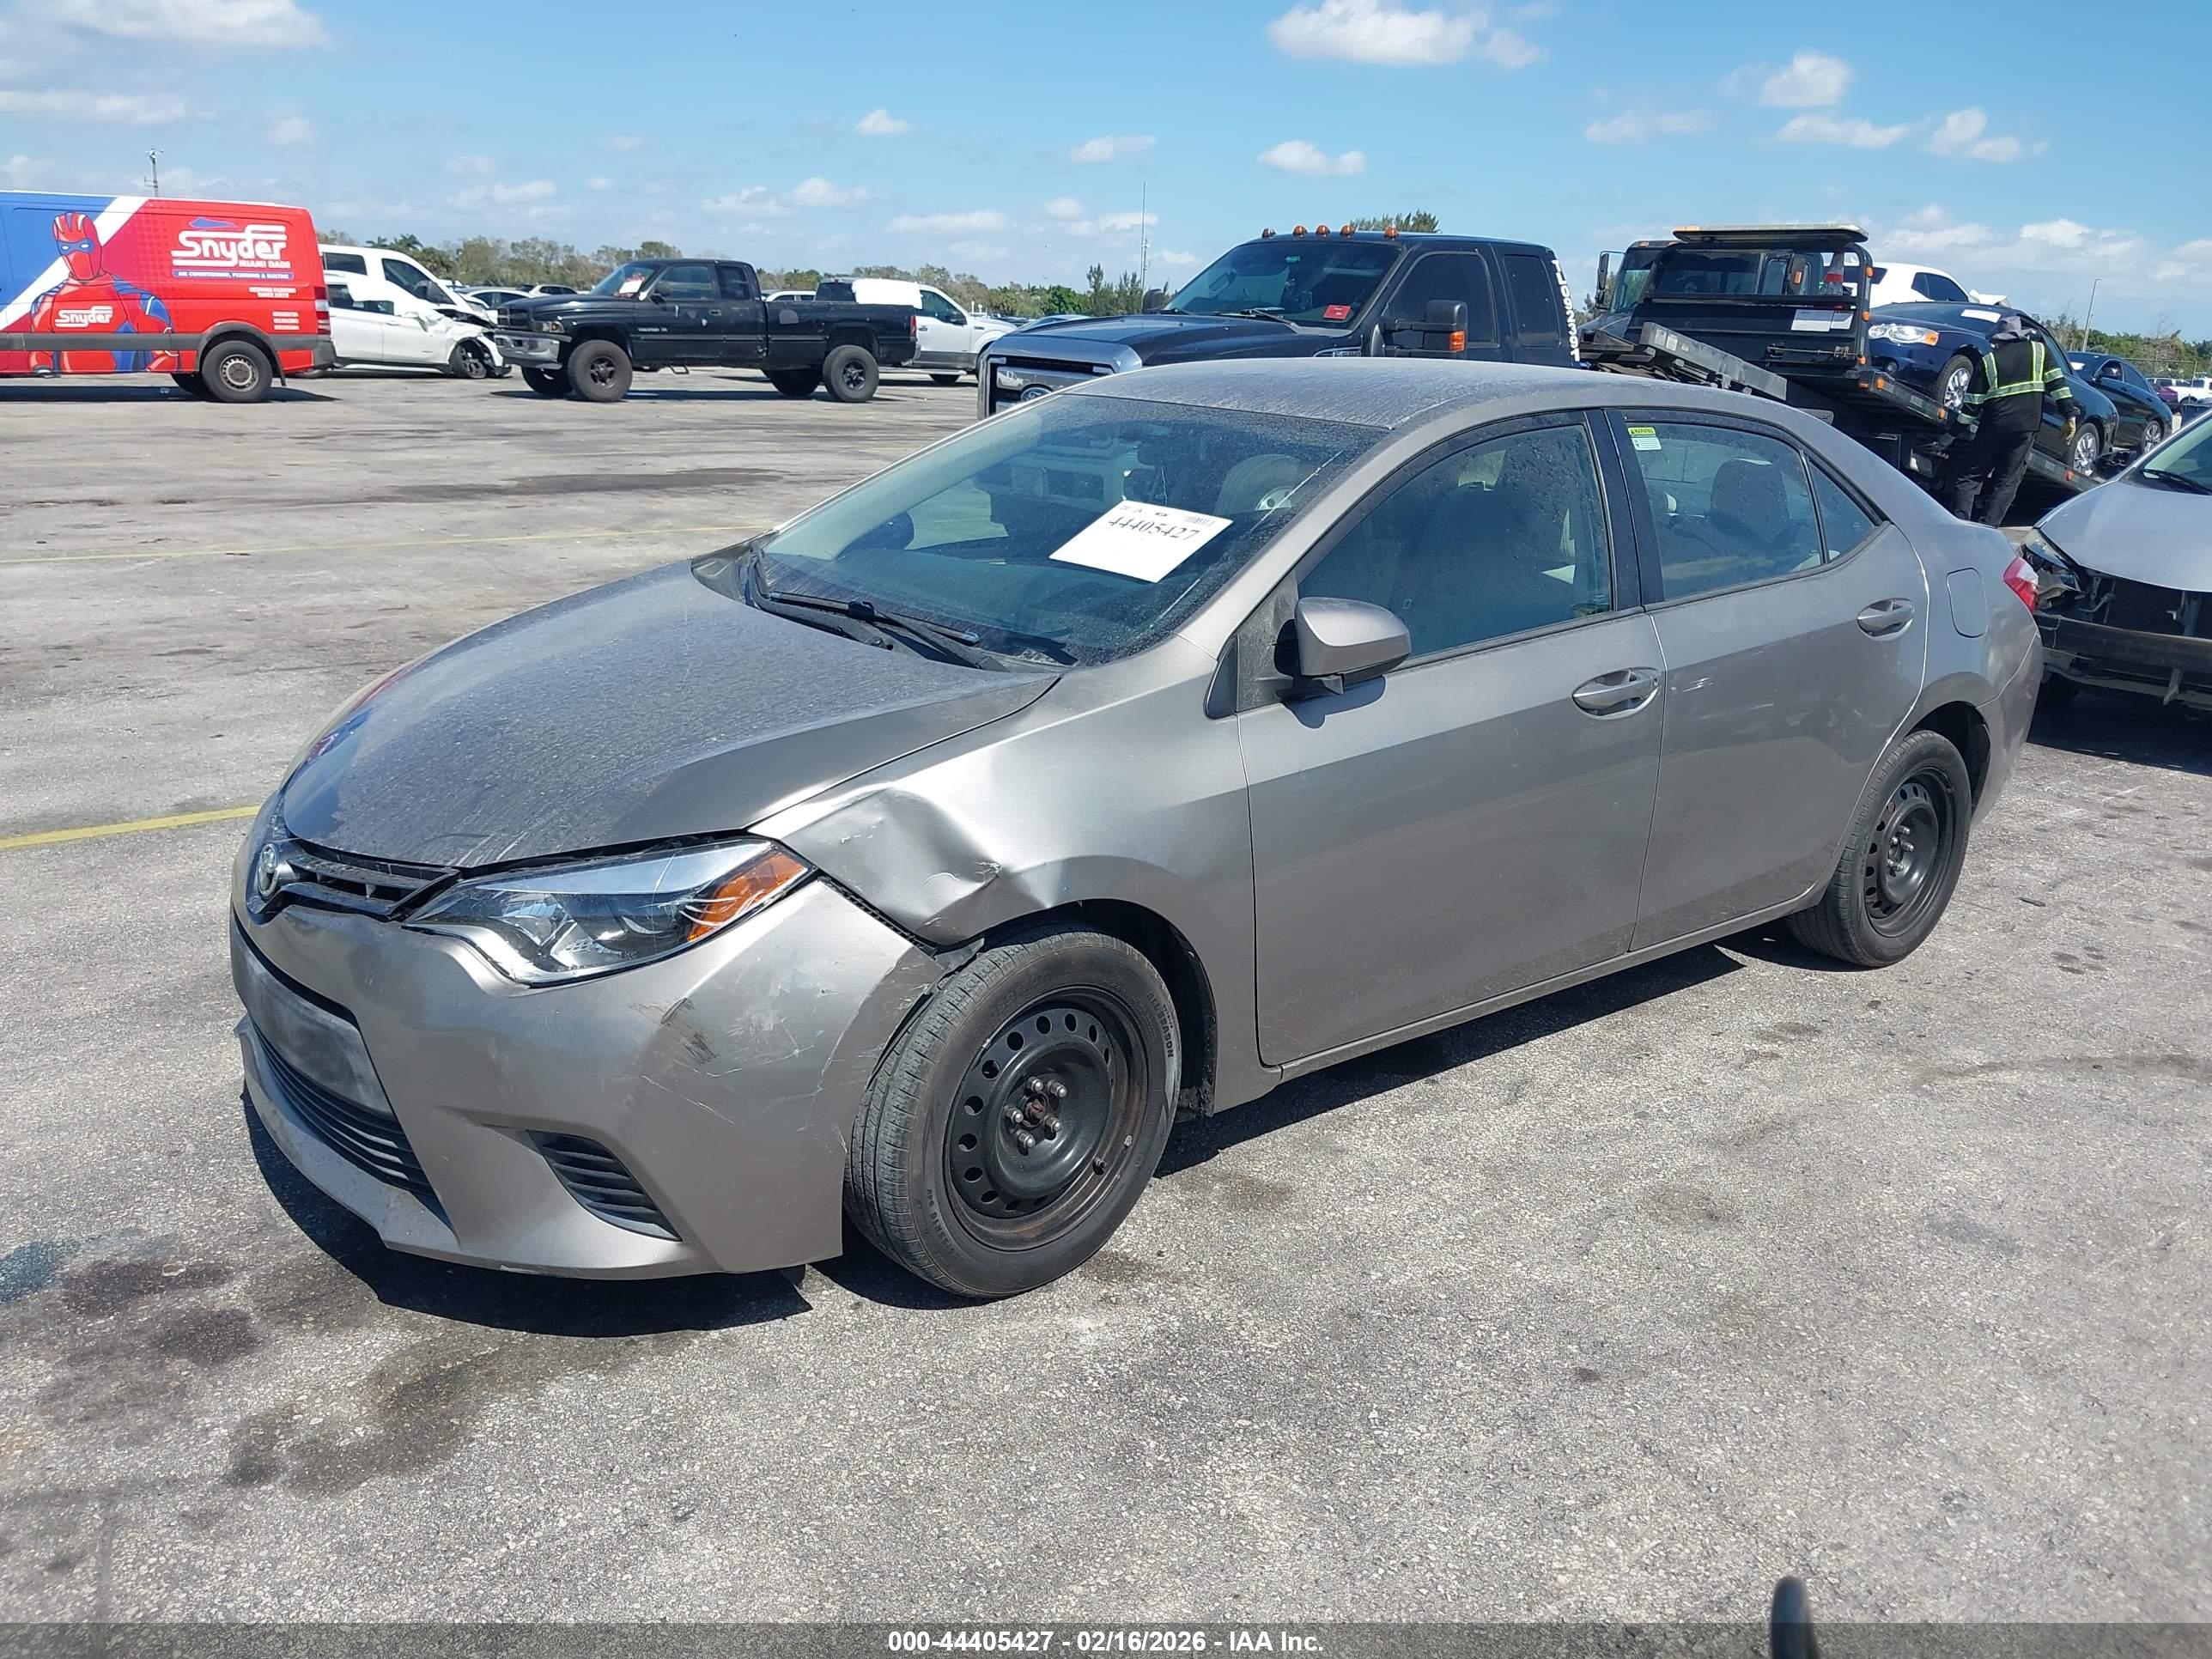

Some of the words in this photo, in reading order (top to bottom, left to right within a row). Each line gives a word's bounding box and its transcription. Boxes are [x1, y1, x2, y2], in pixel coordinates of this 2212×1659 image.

[171, 224, 288, 267] Snyder
[55, 306, 112, 327] Snyder
[1108, 516, 1200, 541] 44405427
[1158, 1012, 1174, 1058] SEASON
